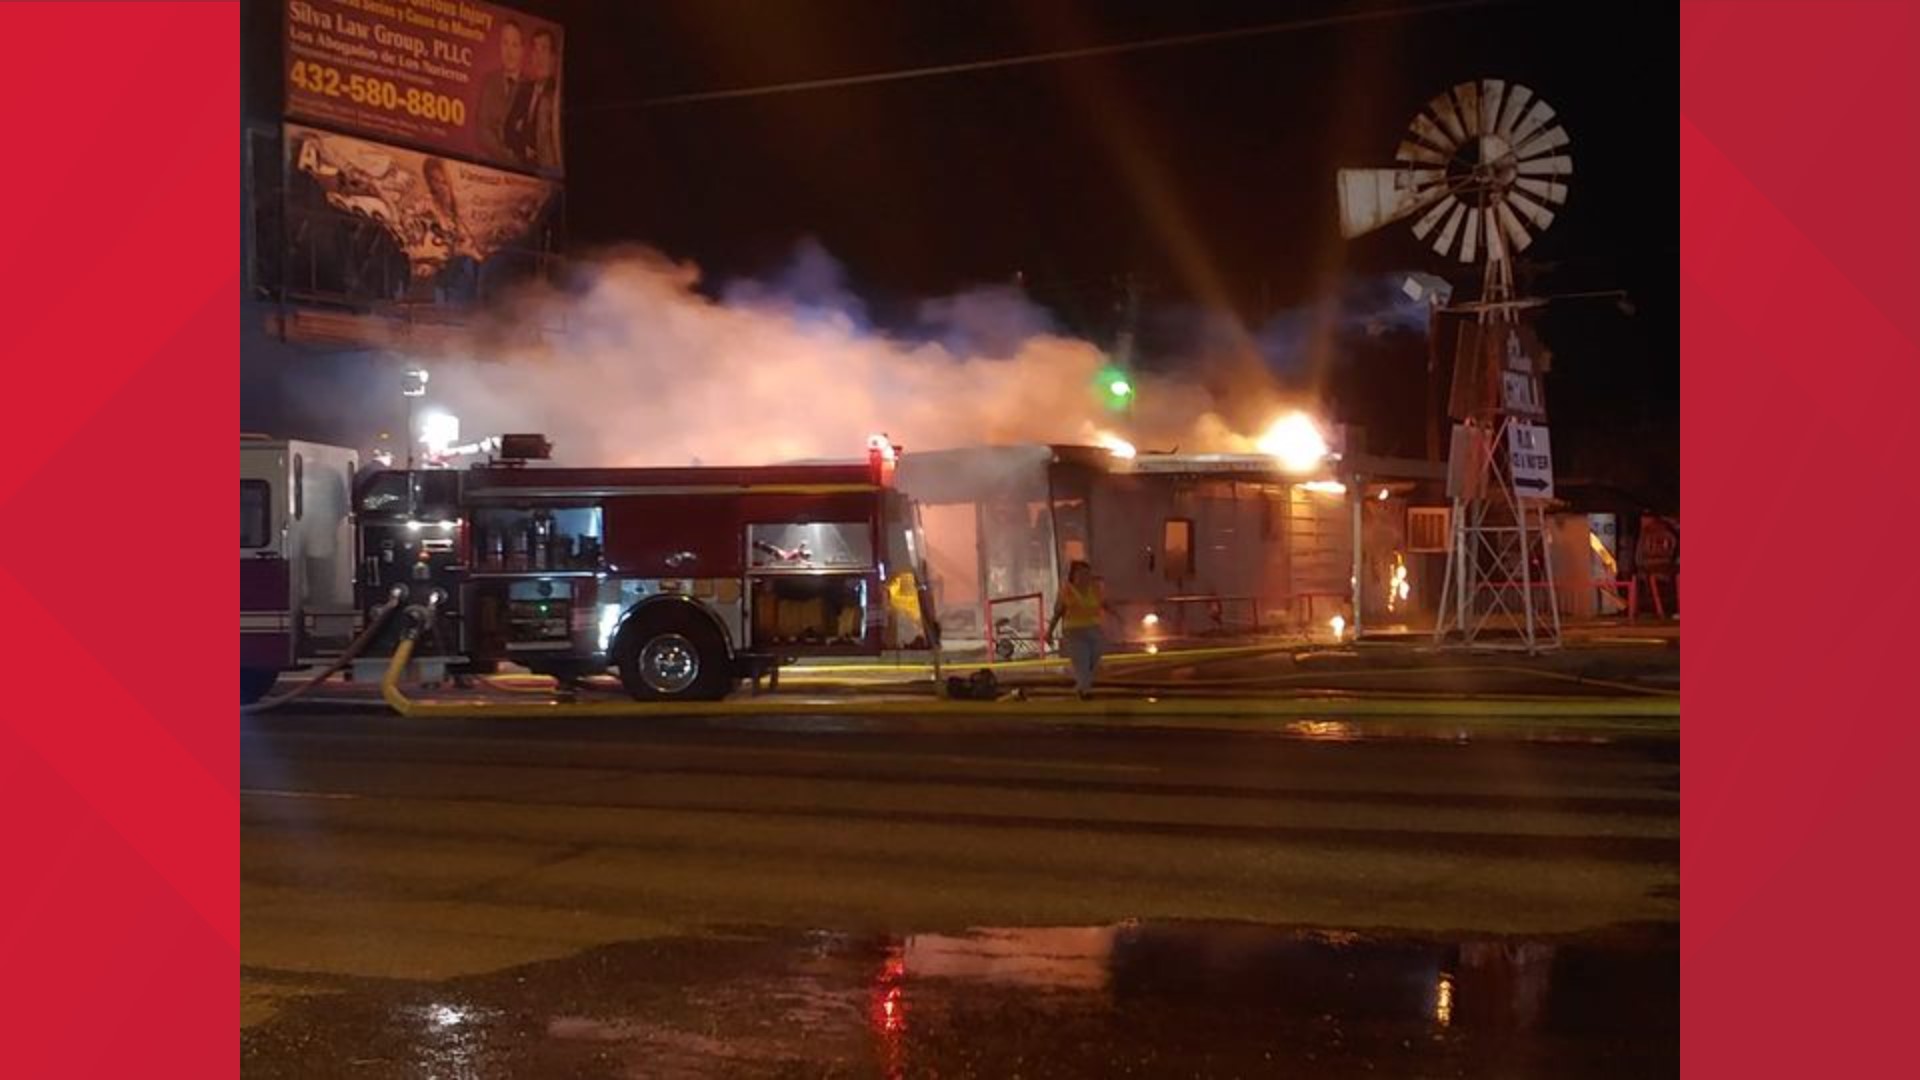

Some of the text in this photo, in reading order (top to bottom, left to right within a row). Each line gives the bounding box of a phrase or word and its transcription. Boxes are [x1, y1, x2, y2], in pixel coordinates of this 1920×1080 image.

[288, 2, 332, 30] Silva
[336, 13, 370, 40] Law
[374, 23, 430, 57] Group,
[433, 39, 473, 67] PLLC
[459, 2, 494, 29] Injury
[289, 25, 314, 43] Los
[317, 33, 379, 61] Abogados
[381, 47, 397, 63] de
[399, 53, 421, 71] Los
[290, 60, 466, 126] 432-580-8800
